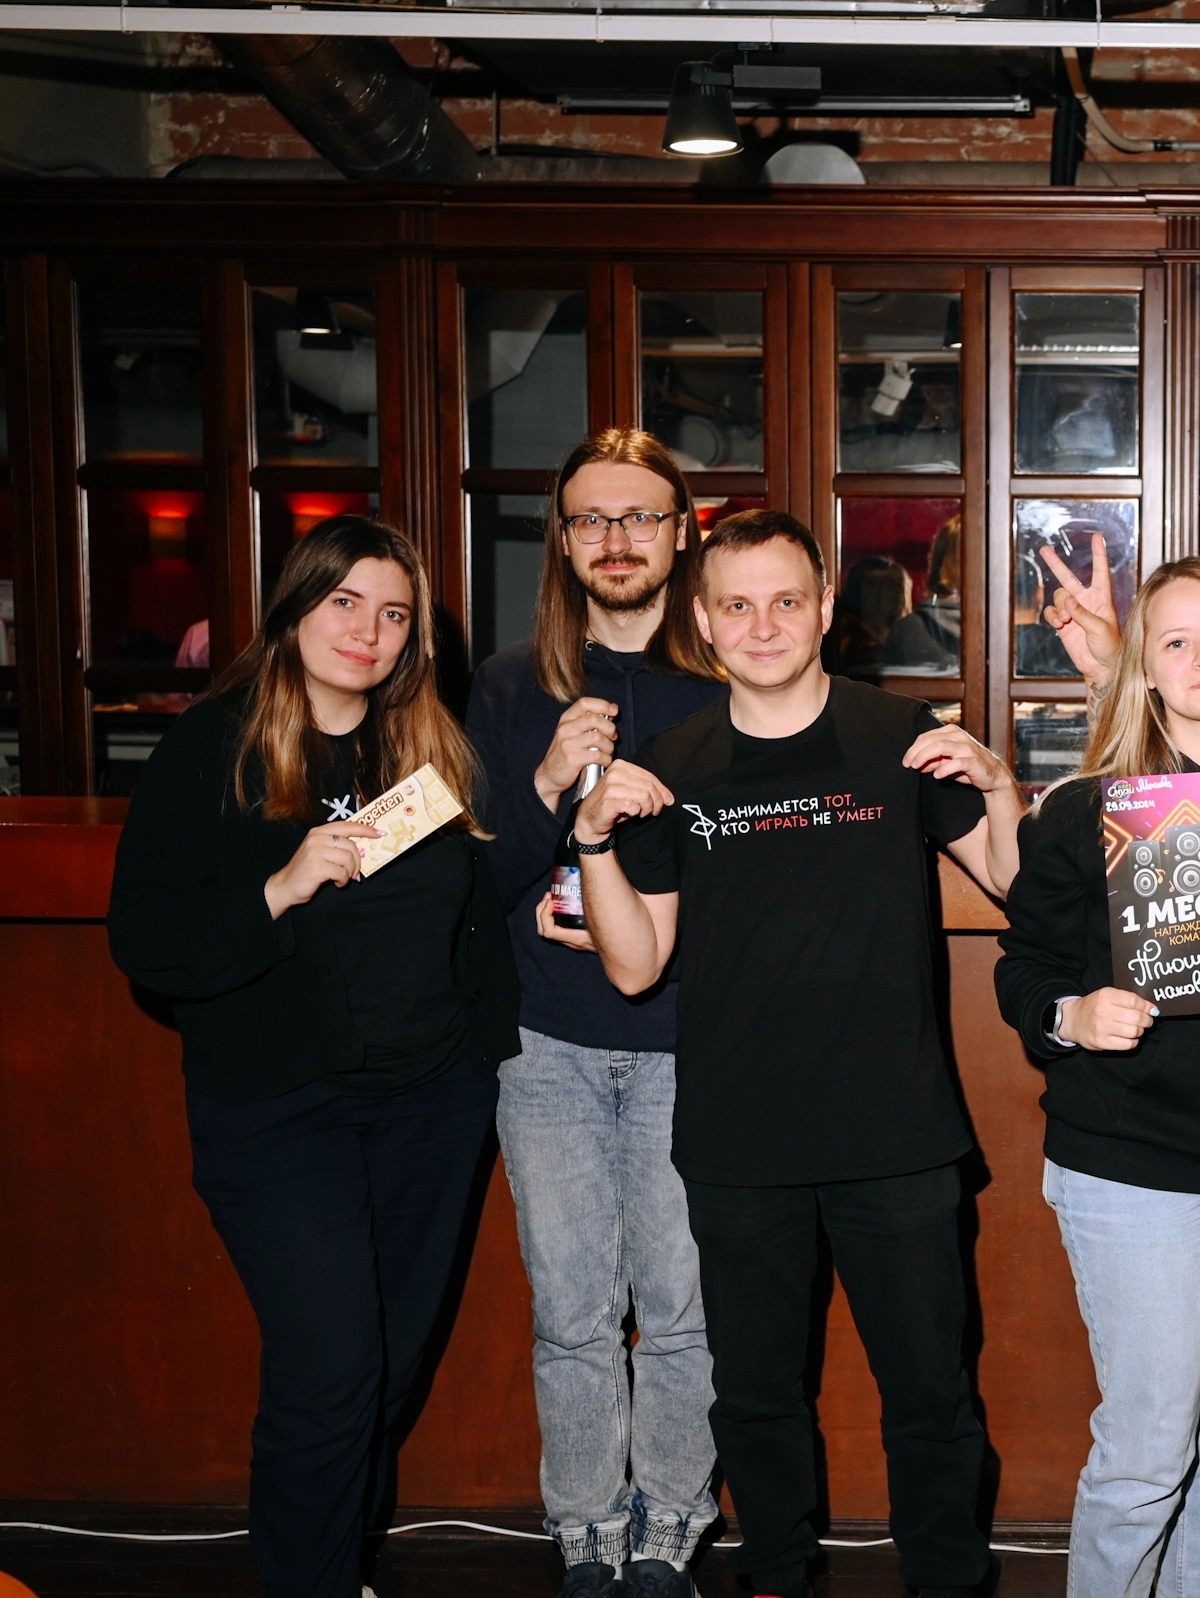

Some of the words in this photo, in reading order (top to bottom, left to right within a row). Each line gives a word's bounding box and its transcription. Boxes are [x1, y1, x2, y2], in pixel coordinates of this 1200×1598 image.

[1107, 786, 1135, 798] Смузи
[354, 792, 404, 827] ogetten
[717, 797, 819, 822] ЗАНИМАЕТСЯ
[823, 793, 857, 809] ТОТ,
[720, 821, 751, 836] КТО
[754, 815, 809, 832] ИГРАТЬ
[812, 812, 832, 825] НЕ
[836, 806, 884, 823] УМЕЕТ
[1121, 905, 1141, 933] 1
